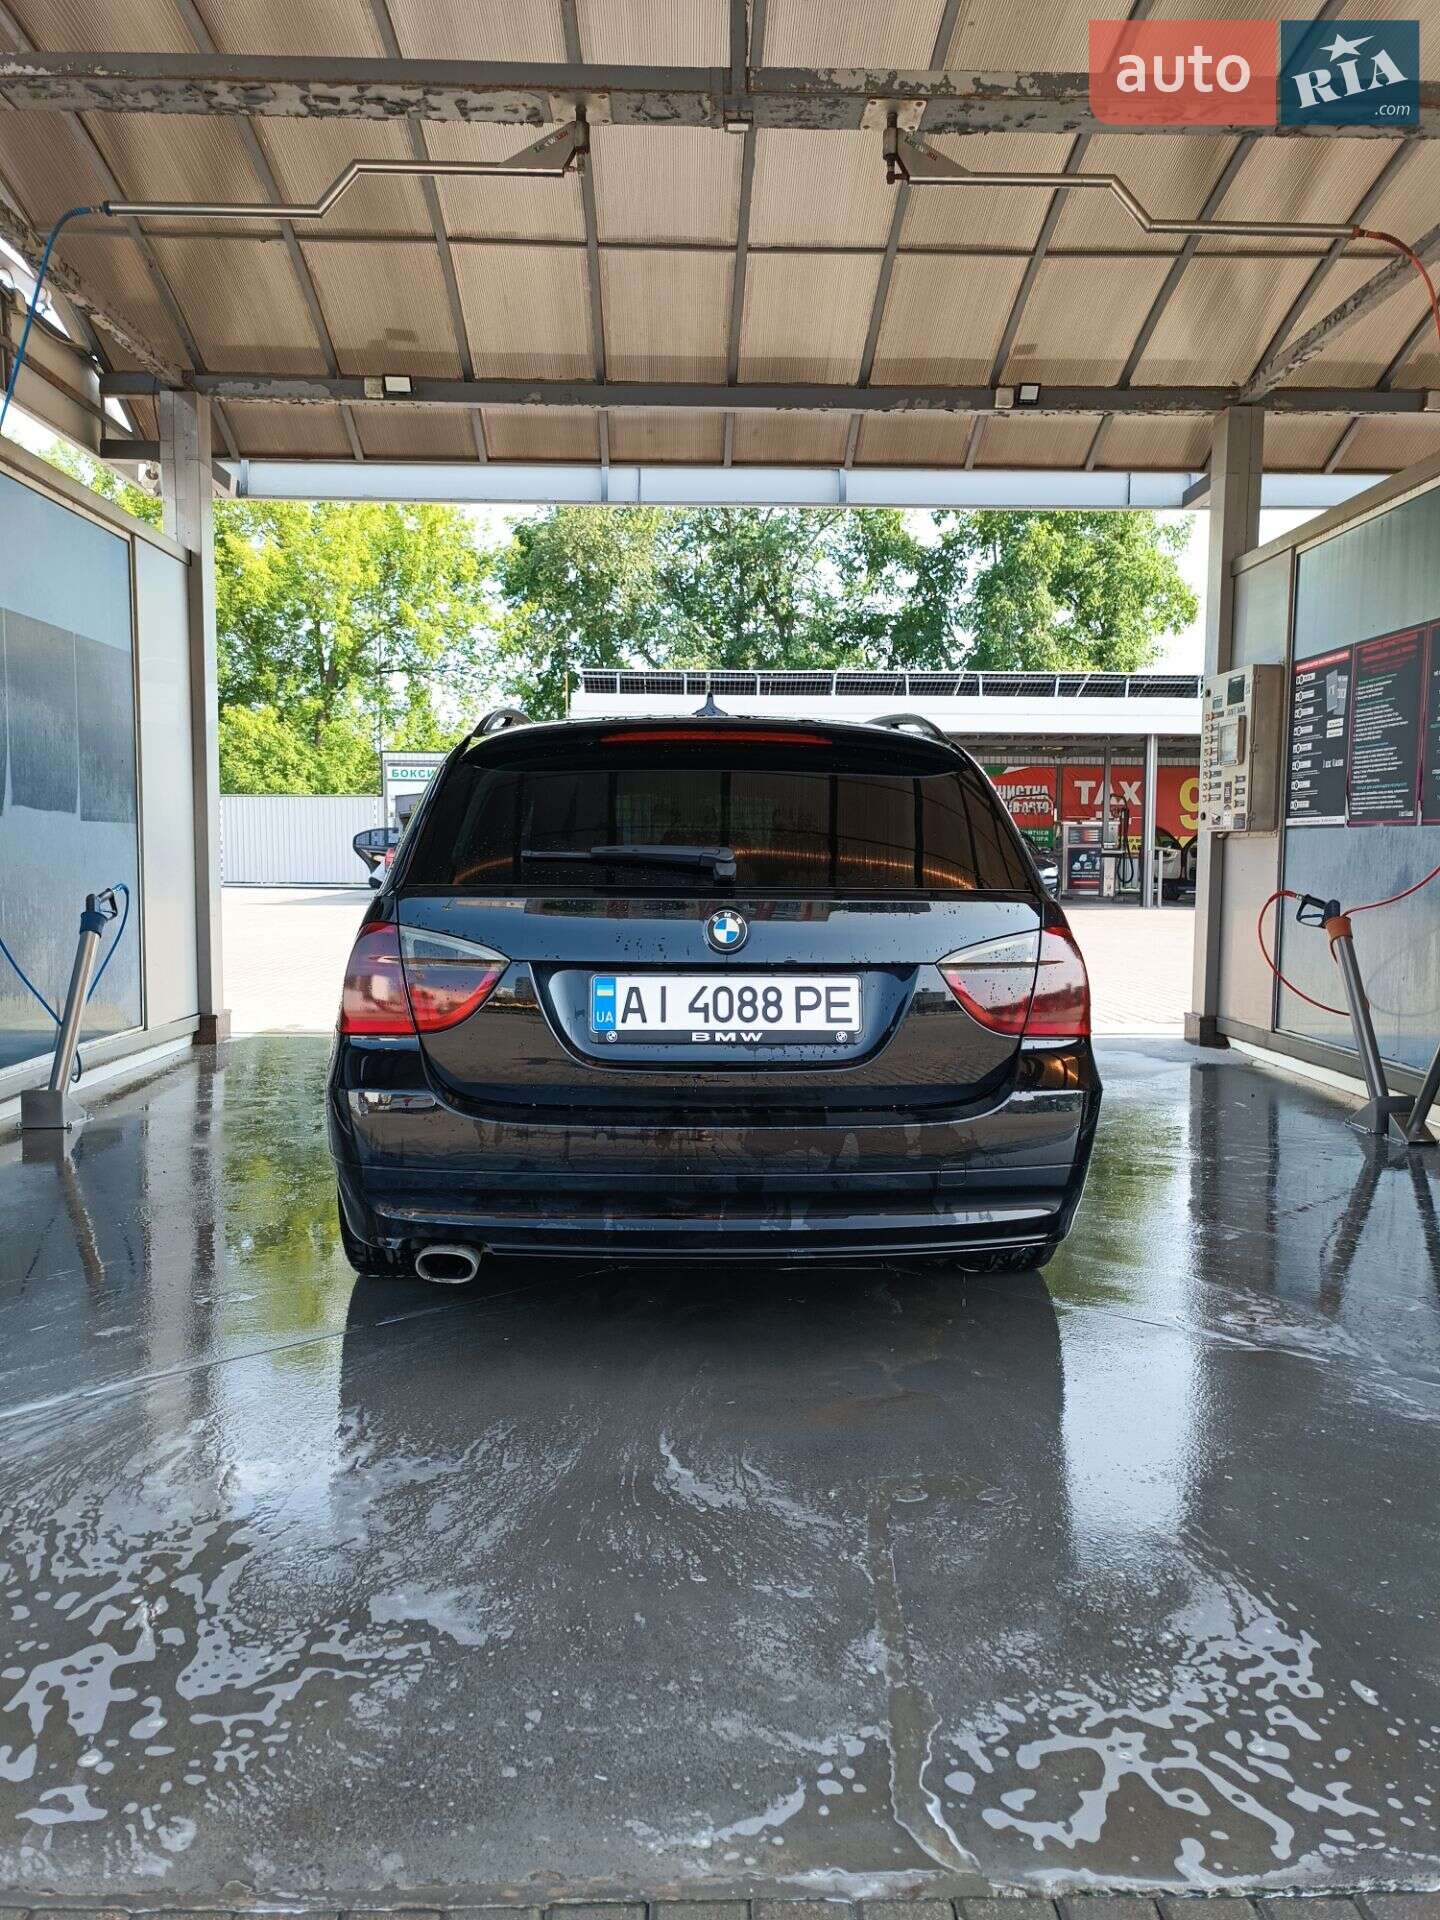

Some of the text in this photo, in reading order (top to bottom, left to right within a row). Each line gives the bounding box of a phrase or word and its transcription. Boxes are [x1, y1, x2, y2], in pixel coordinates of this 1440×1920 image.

[620, 986, 853, 1024] AI 4088 PE
[596, 1012, 614, 1024] UA
[691, 1032, 763, 1042] BMW
